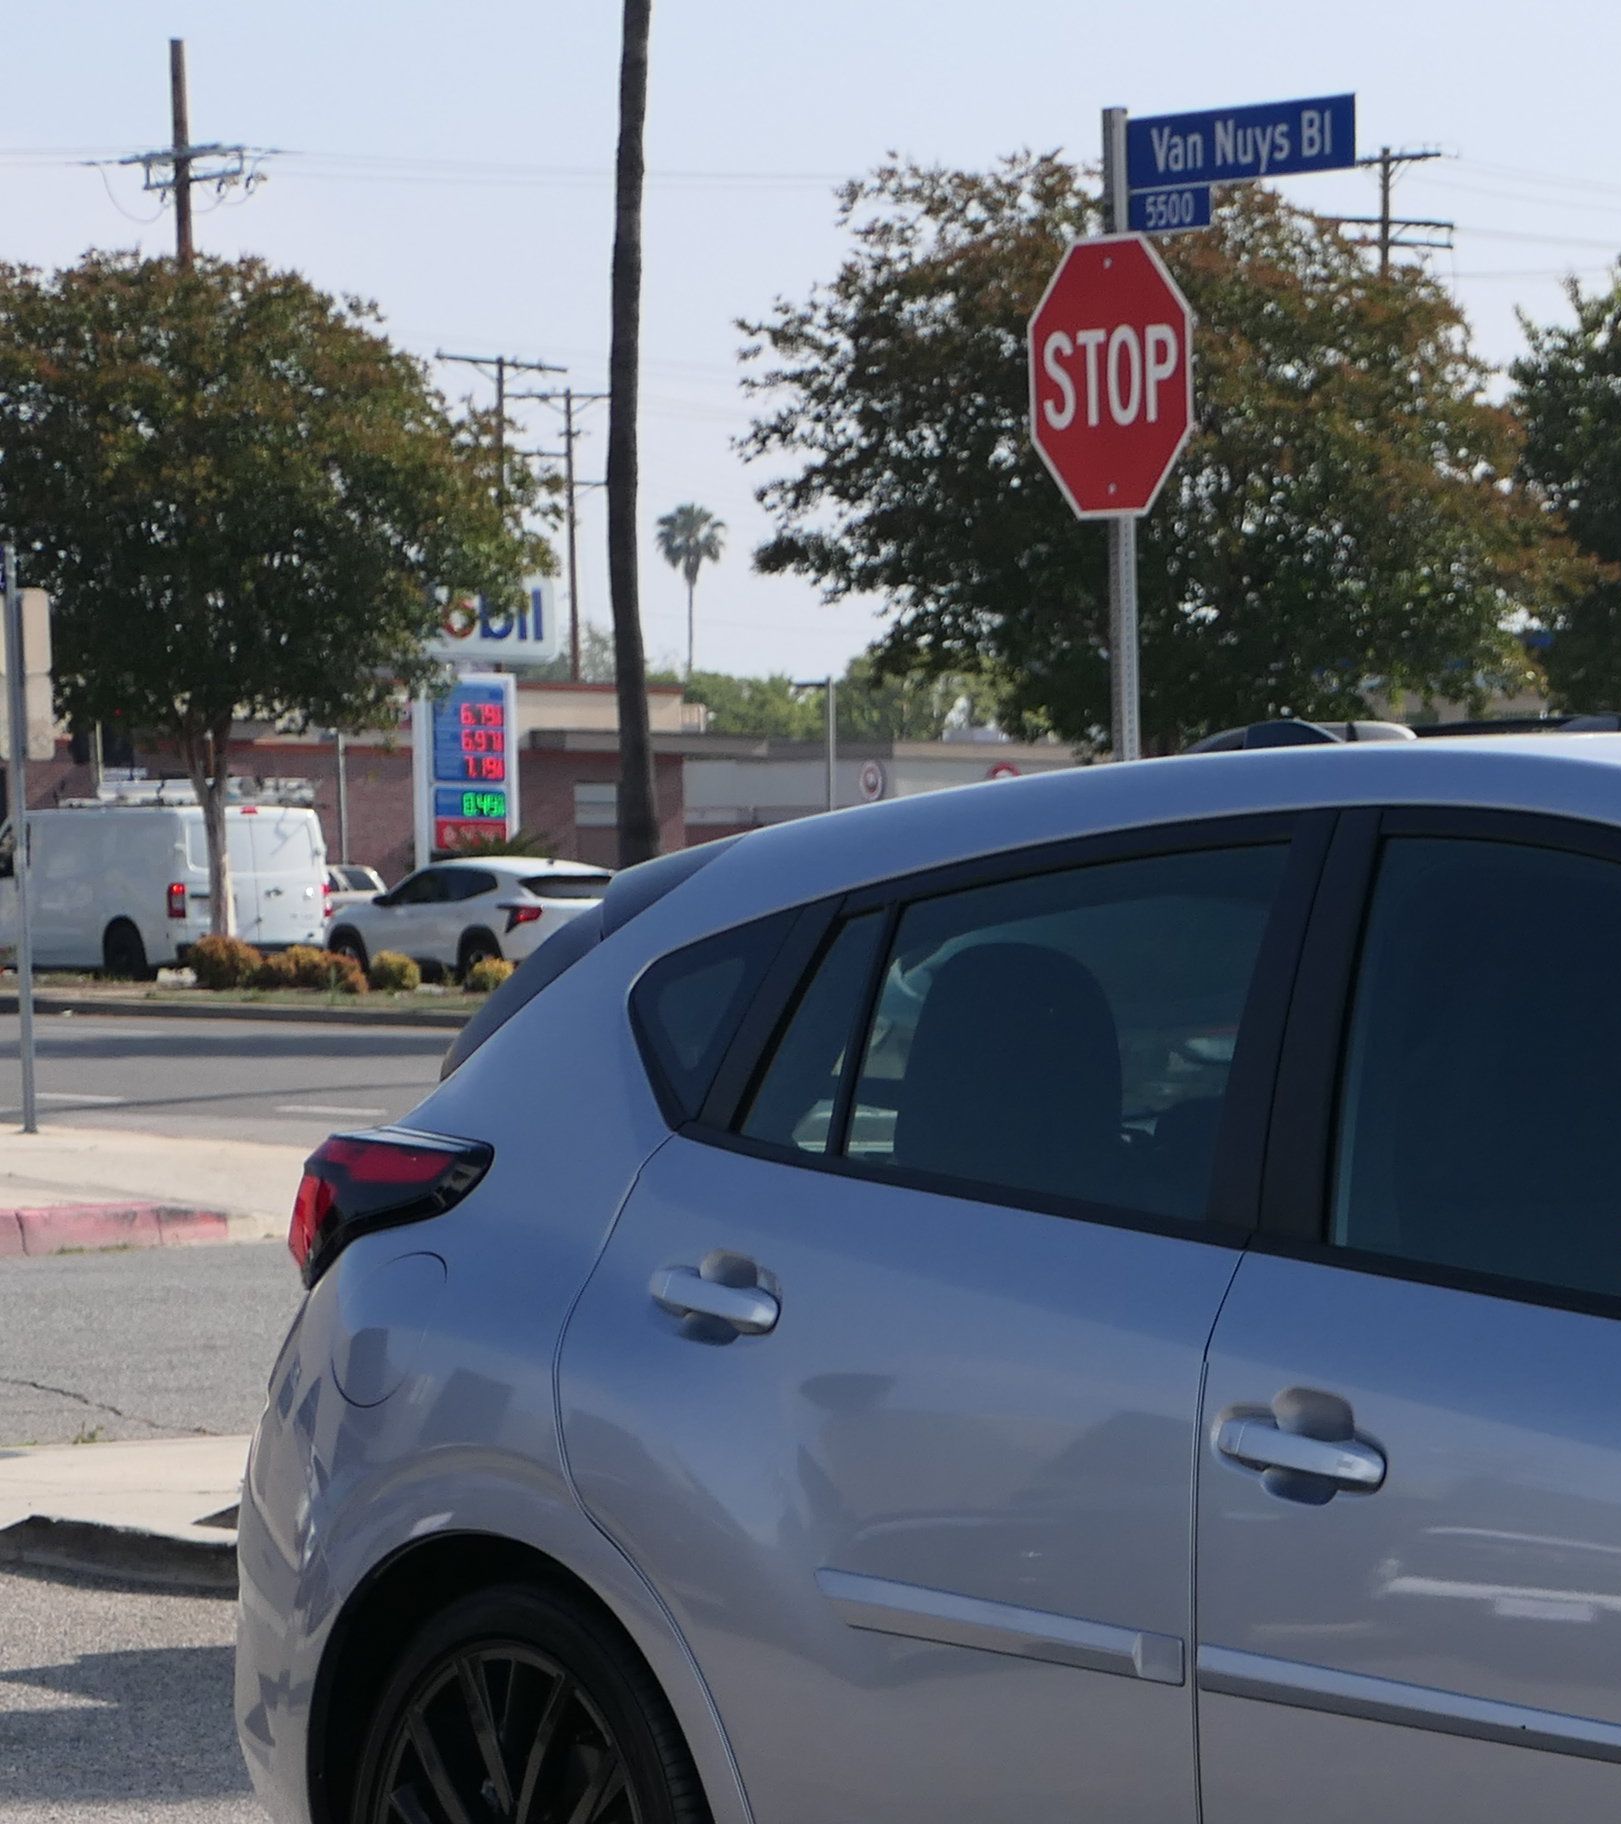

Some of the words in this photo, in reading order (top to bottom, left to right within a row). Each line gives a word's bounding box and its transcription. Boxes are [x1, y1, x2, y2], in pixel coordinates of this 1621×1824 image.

[1151, 125, 1204, 174] Van
[1214, 118, 1291, 174] Nuys
[1300, 109, 1333, 158] Bl
[1145, 191, 1196, 229] 5500
[1043, 323, 1179, 431] STOP
[440, 588, 544, 641] obil
